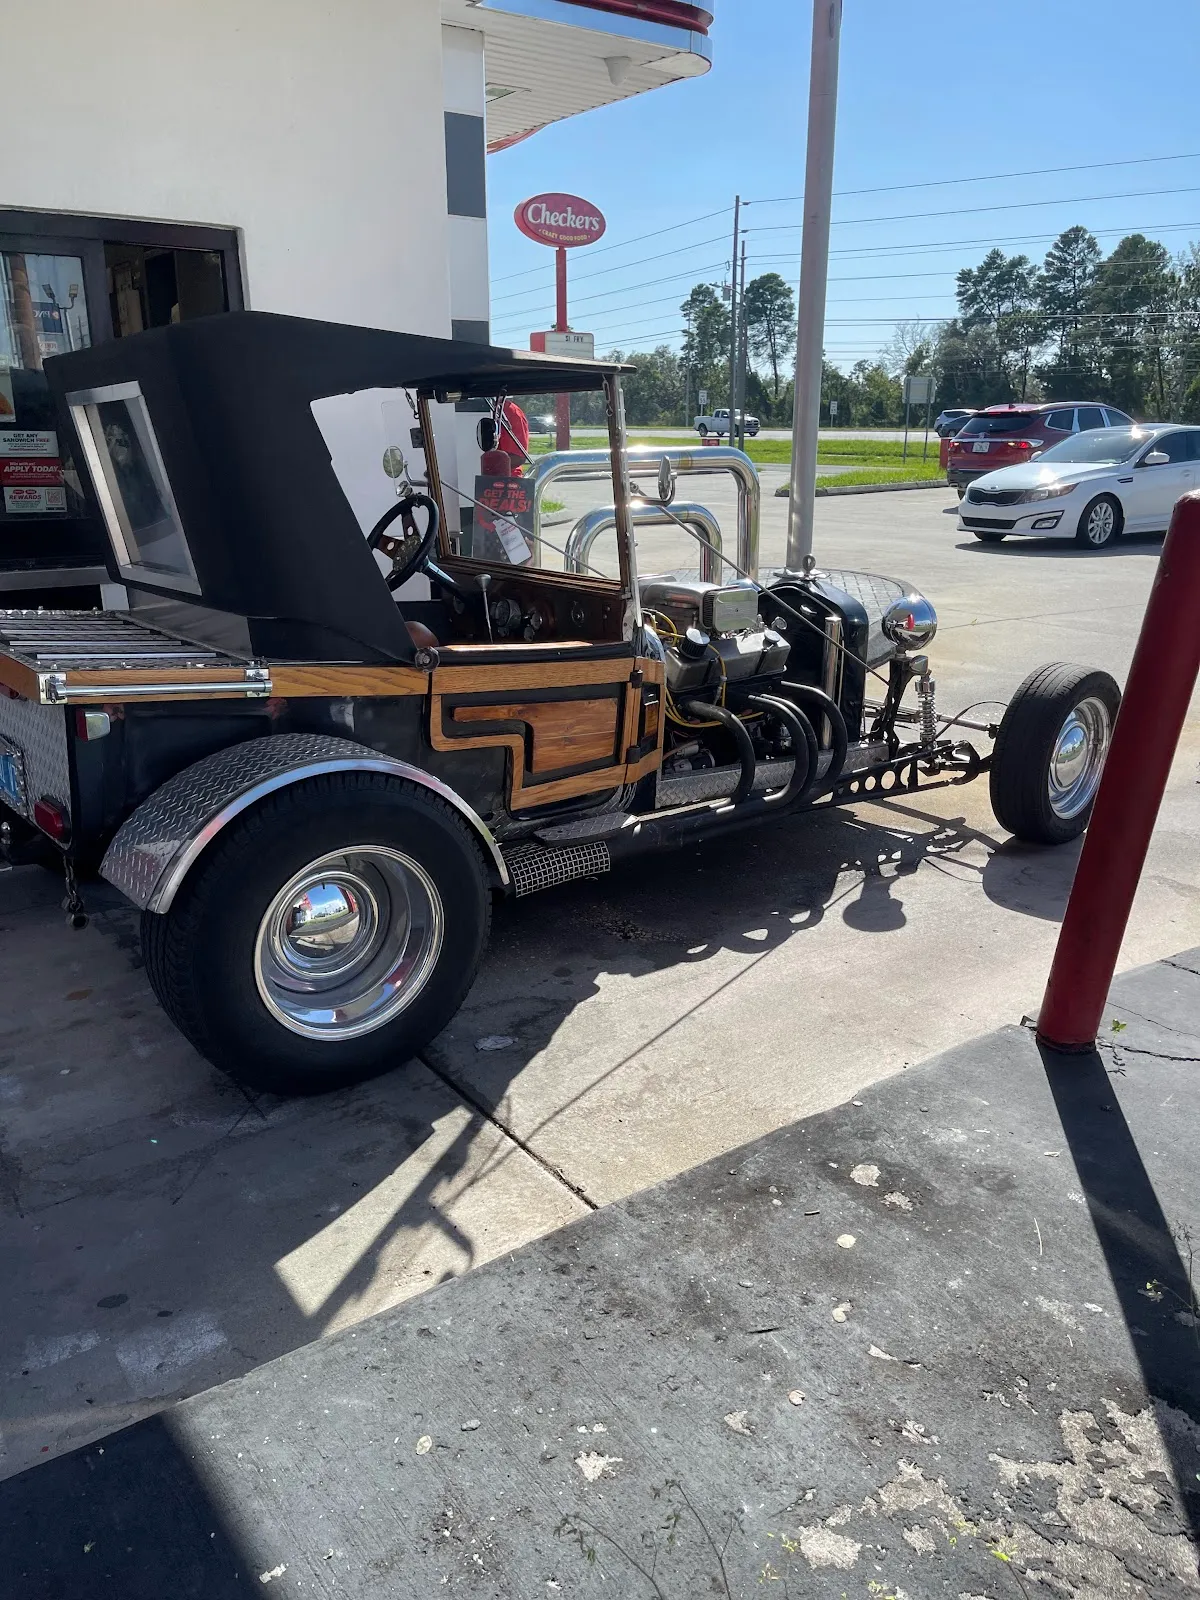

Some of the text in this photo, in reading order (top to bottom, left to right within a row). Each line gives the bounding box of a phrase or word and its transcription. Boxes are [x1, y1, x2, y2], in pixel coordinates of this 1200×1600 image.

[527, 203, 599, 231] Checkers
[484, 489, 526, 499] GET THE
